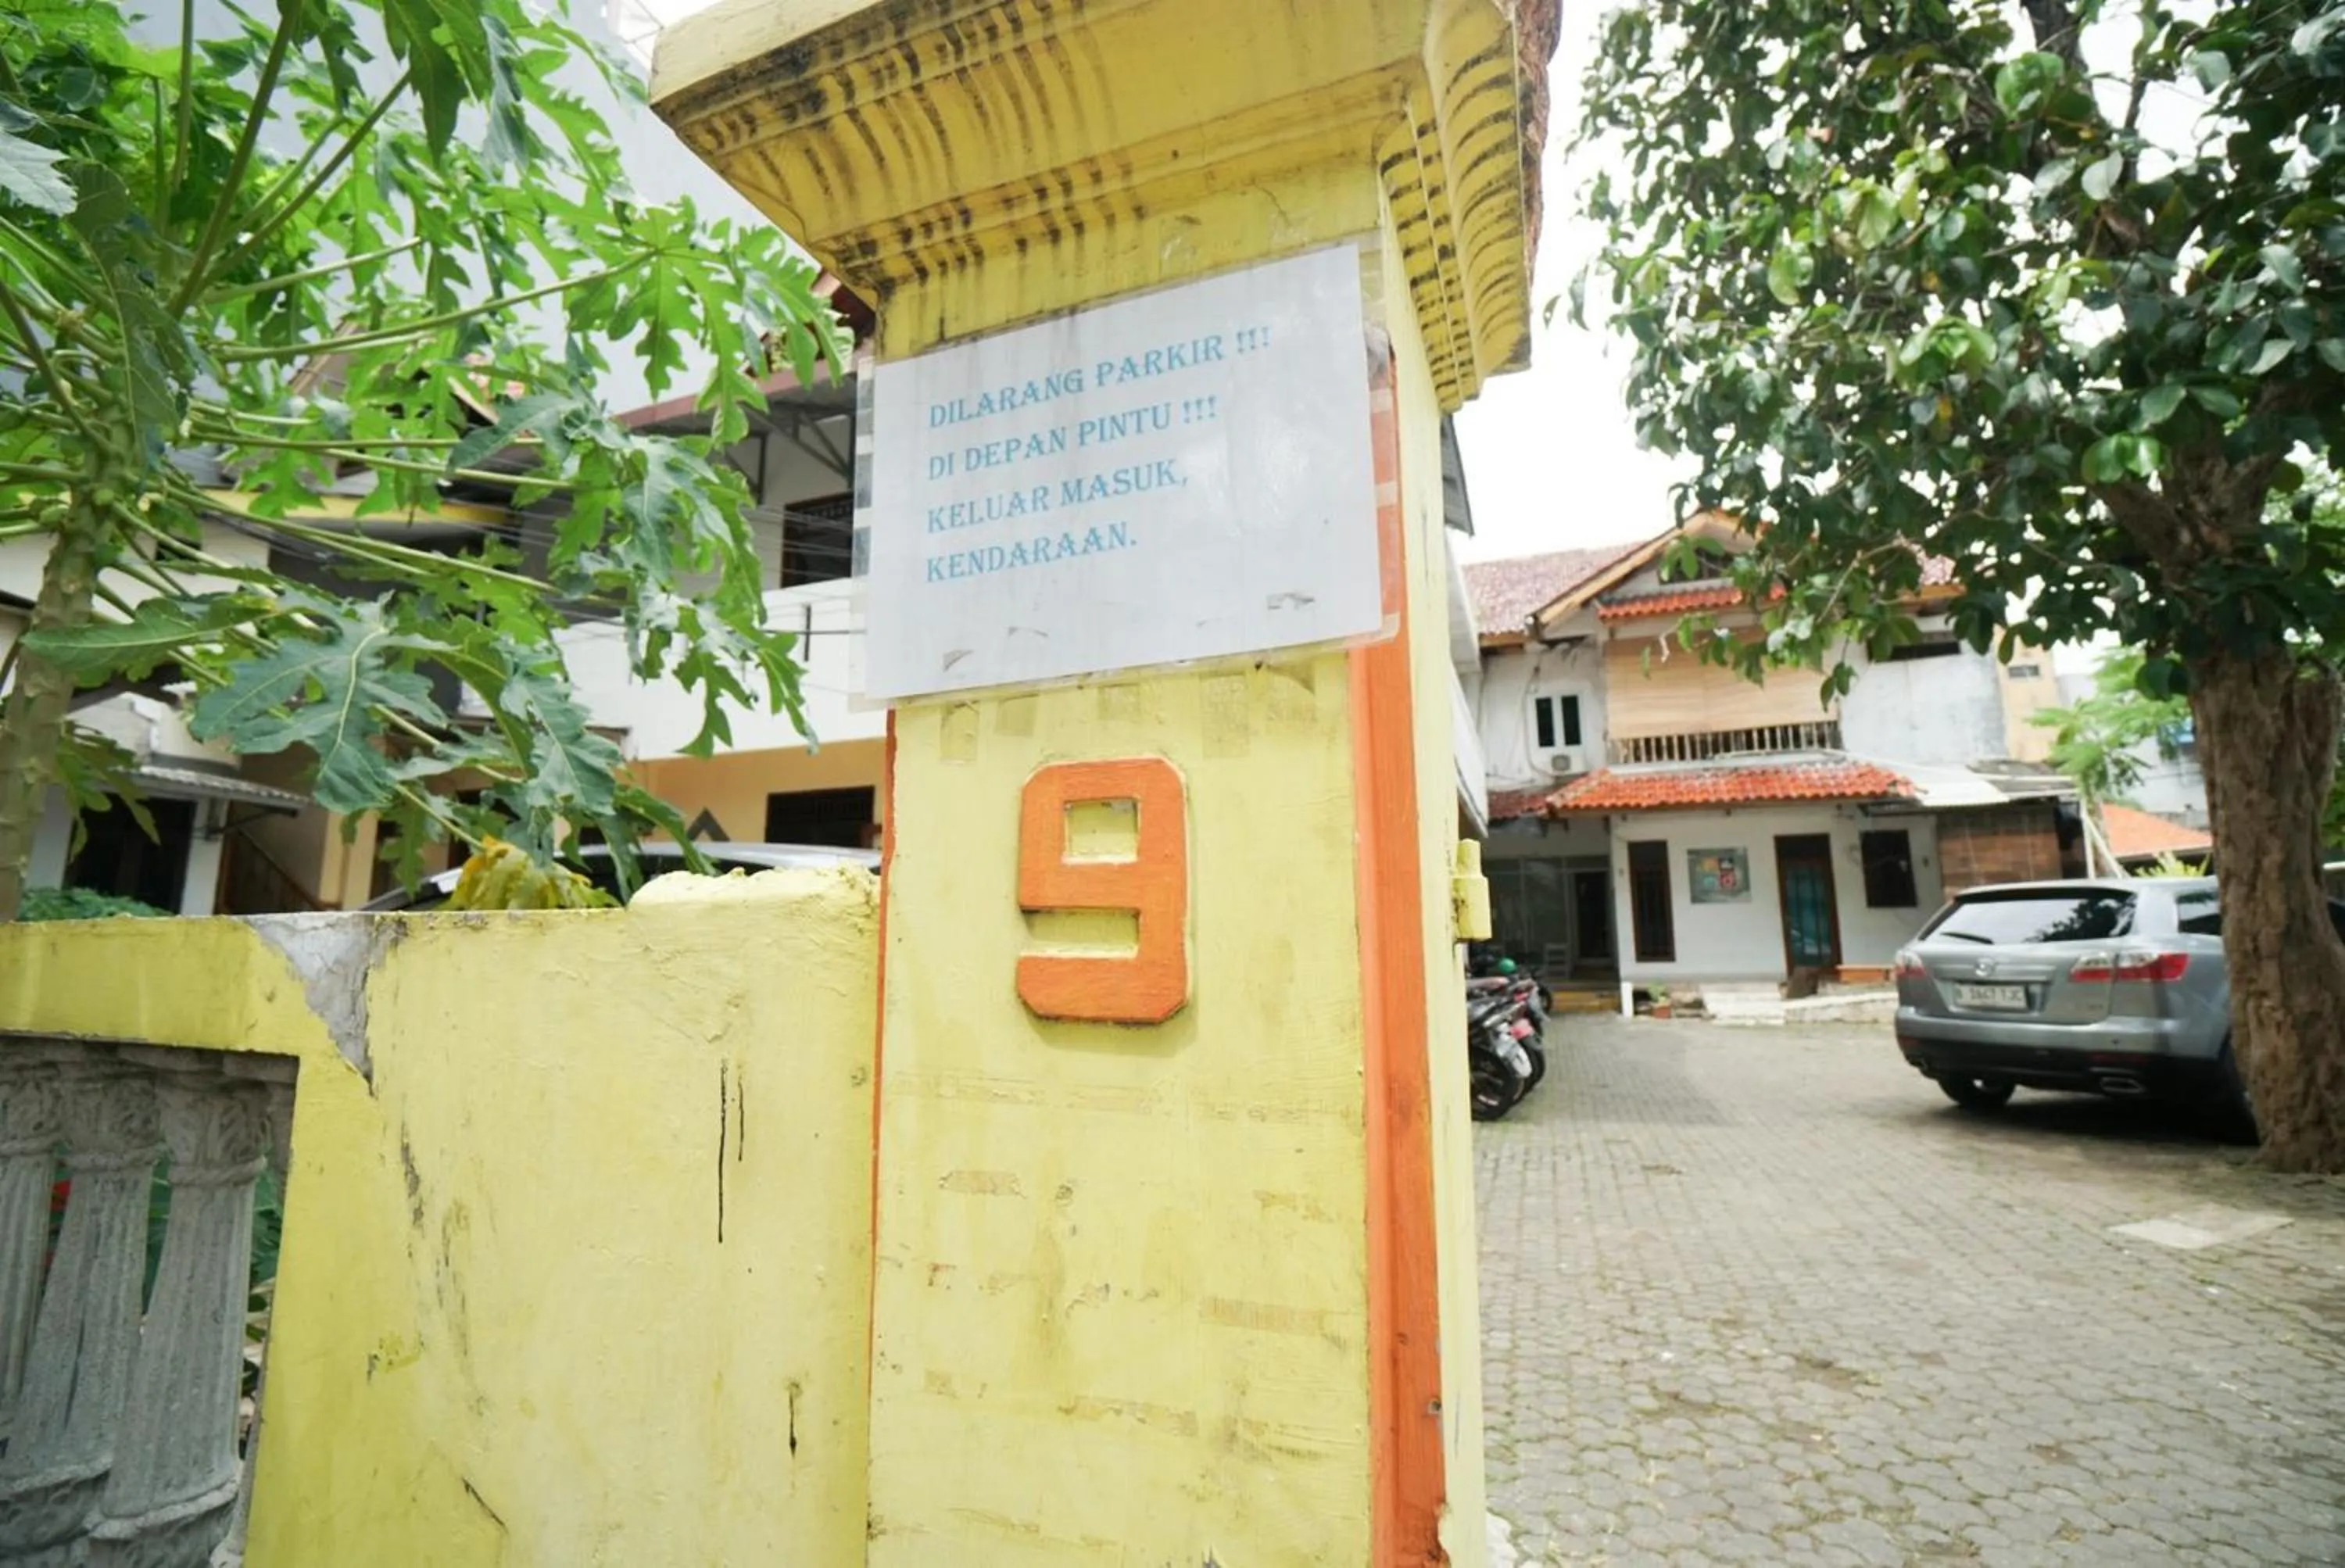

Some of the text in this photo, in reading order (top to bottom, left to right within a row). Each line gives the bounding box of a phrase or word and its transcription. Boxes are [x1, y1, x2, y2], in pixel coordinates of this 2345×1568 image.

[929, 328, 1270, 428] DILARANG PARKIR !!!
[929, 396, 1217, 480] DI DEPAN PINTU !!!
[928, 460, 1188, 534] KELUAR MASUK,
[927, 522, 1137, 583] KENDARAAN.
[1018, 756, 1188, 1025] 9
